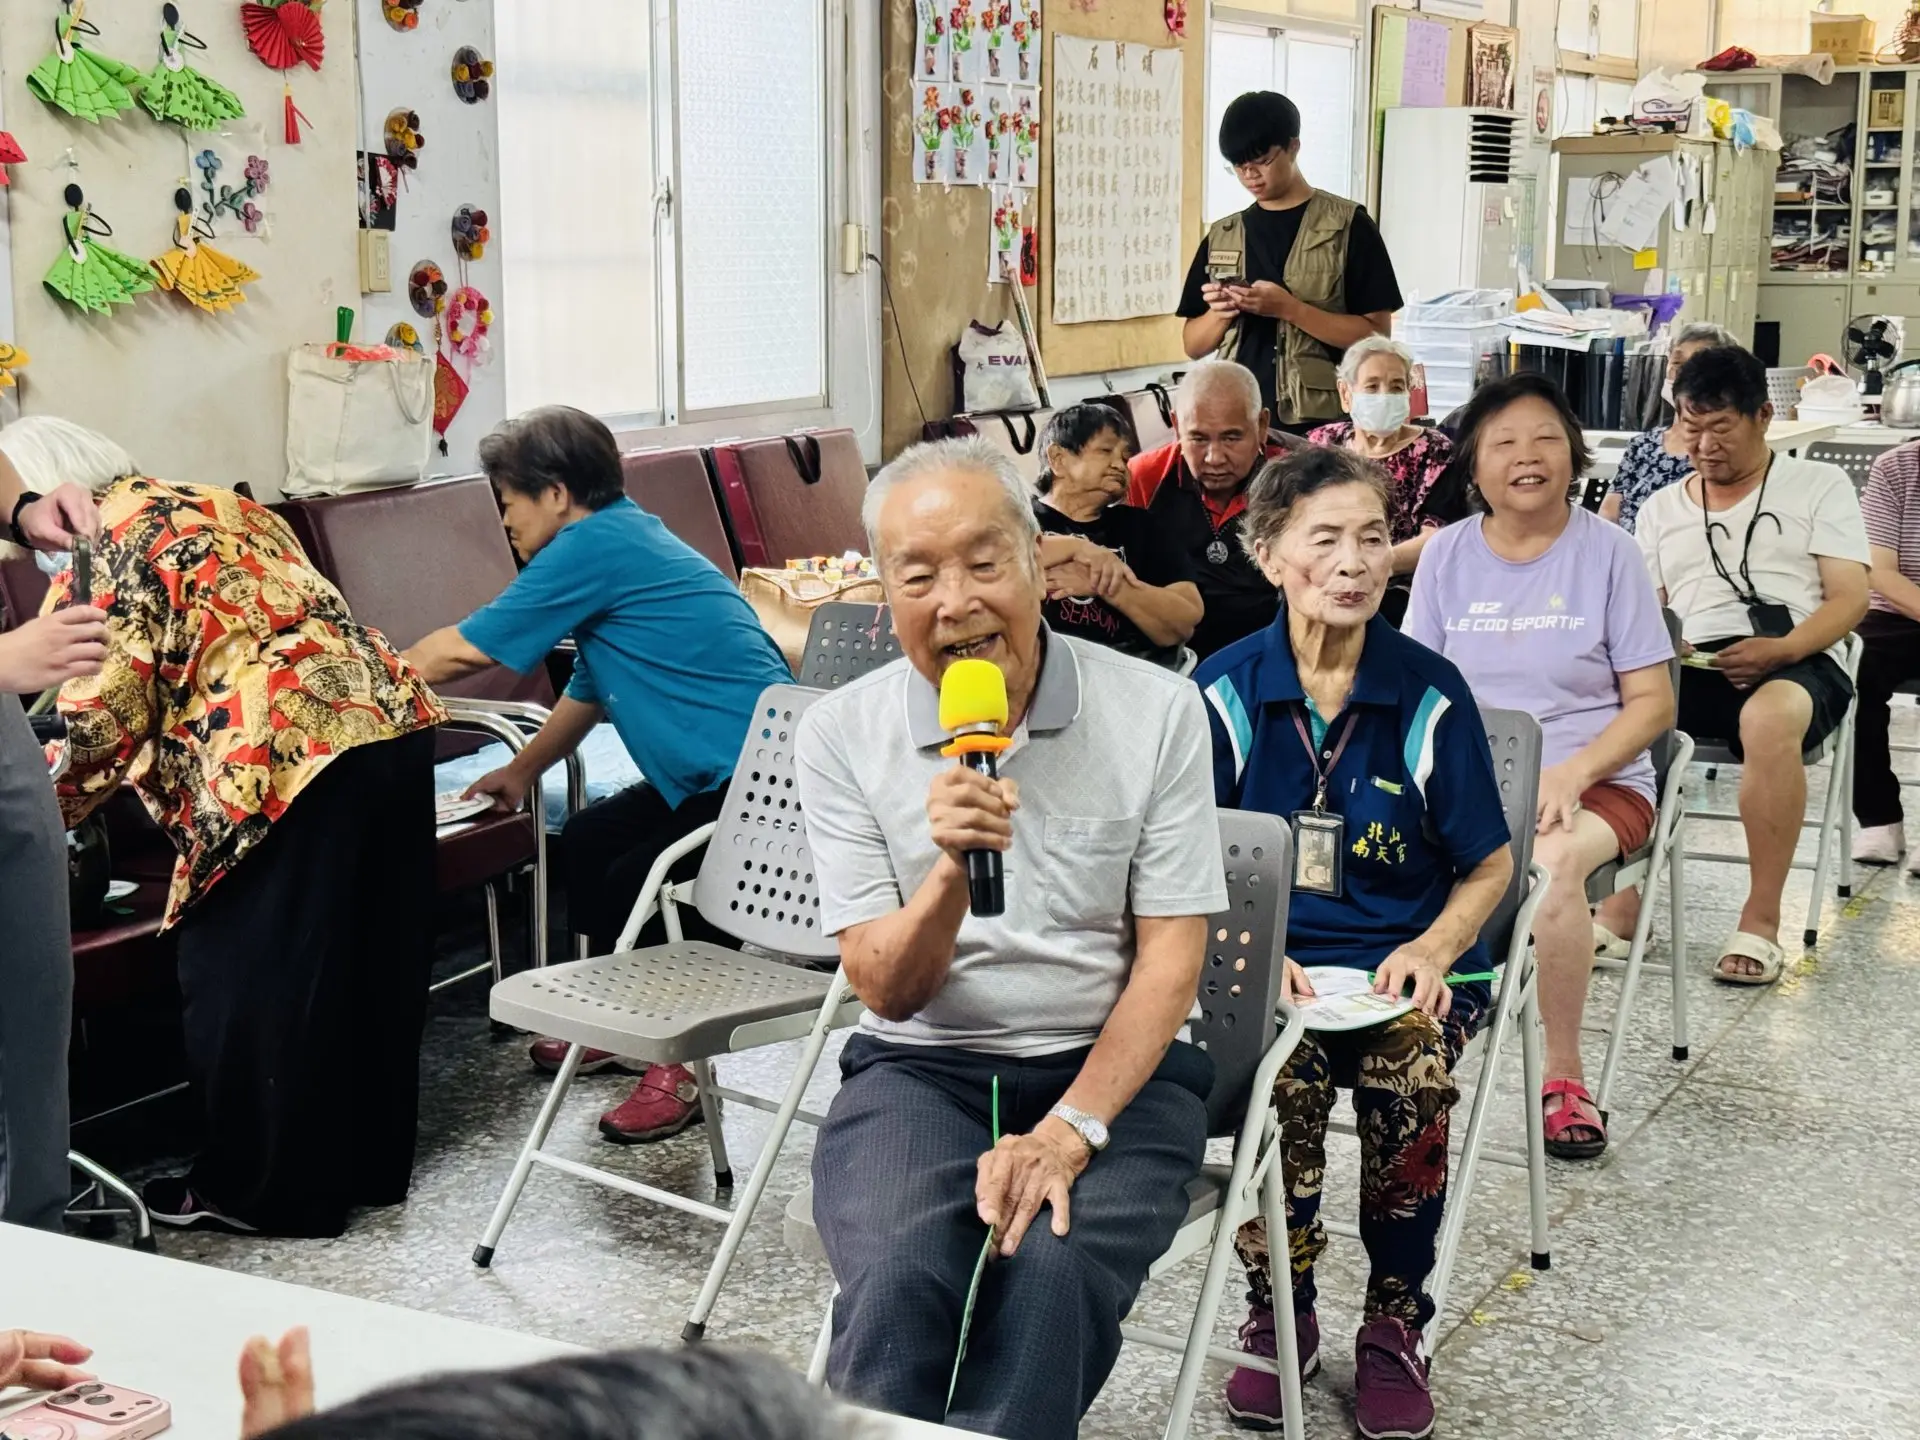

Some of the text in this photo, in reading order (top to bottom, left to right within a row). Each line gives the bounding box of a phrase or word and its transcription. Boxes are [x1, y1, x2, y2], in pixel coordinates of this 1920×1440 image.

[1445, 617, 1471, 632] LE
[1511, 615, 1585, 631] SPORTIF
[1368, 821, 1401, 844] 北山
